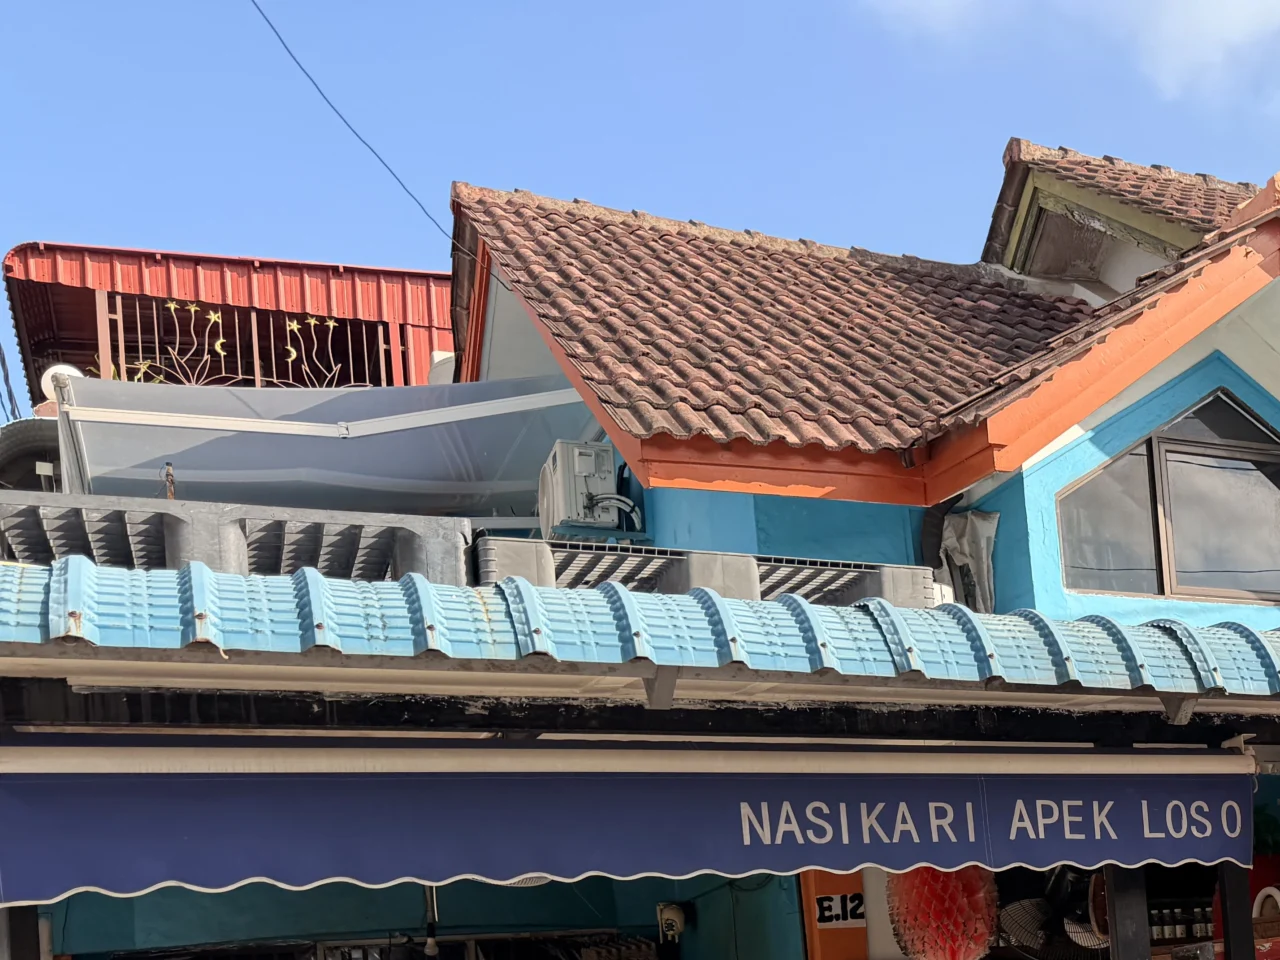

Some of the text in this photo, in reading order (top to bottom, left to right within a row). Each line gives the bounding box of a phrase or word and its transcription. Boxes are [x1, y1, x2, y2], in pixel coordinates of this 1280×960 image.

[1008, 799, 1117, 841] APEK
[1141, 799, 1243, 840] LOSO
[817, 893, 865, 923] E.12
